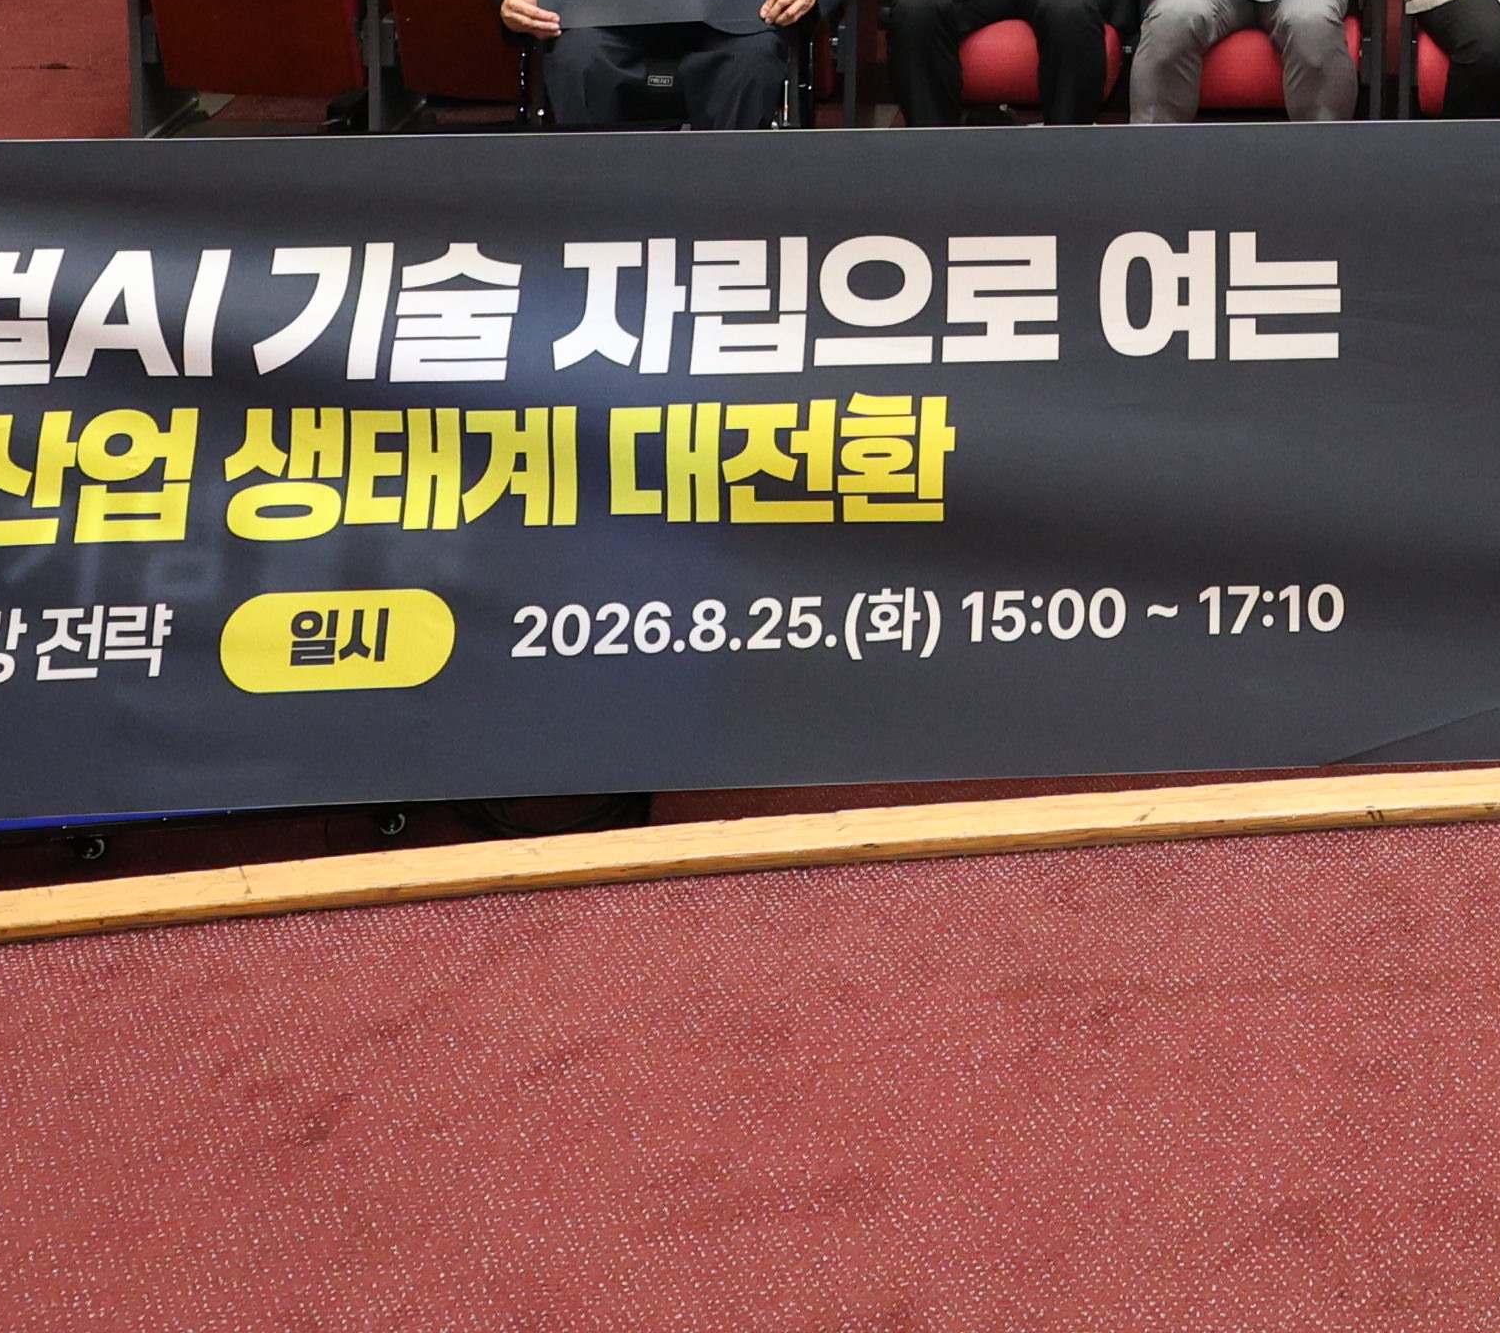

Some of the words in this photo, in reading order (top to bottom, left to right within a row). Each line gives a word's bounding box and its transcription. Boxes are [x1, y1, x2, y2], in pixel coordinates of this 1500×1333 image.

[253, 243, 521, 382] 기술
[553, 236, 1059, 375] 자립으로
[1100, 231, 1340, 360] 여는
[225, 406, 577, 540] 생태계
[610, 392, 955, 522] 대전환
[37, 604, 173, 680] 전략
[290, 608, 389, 666] 일시
[512, 588, 940, 659] 2026.8.25.(화)
[962, 588, 1125, 642] 15:00
[1200, 584, 1344, 634] 17:10
